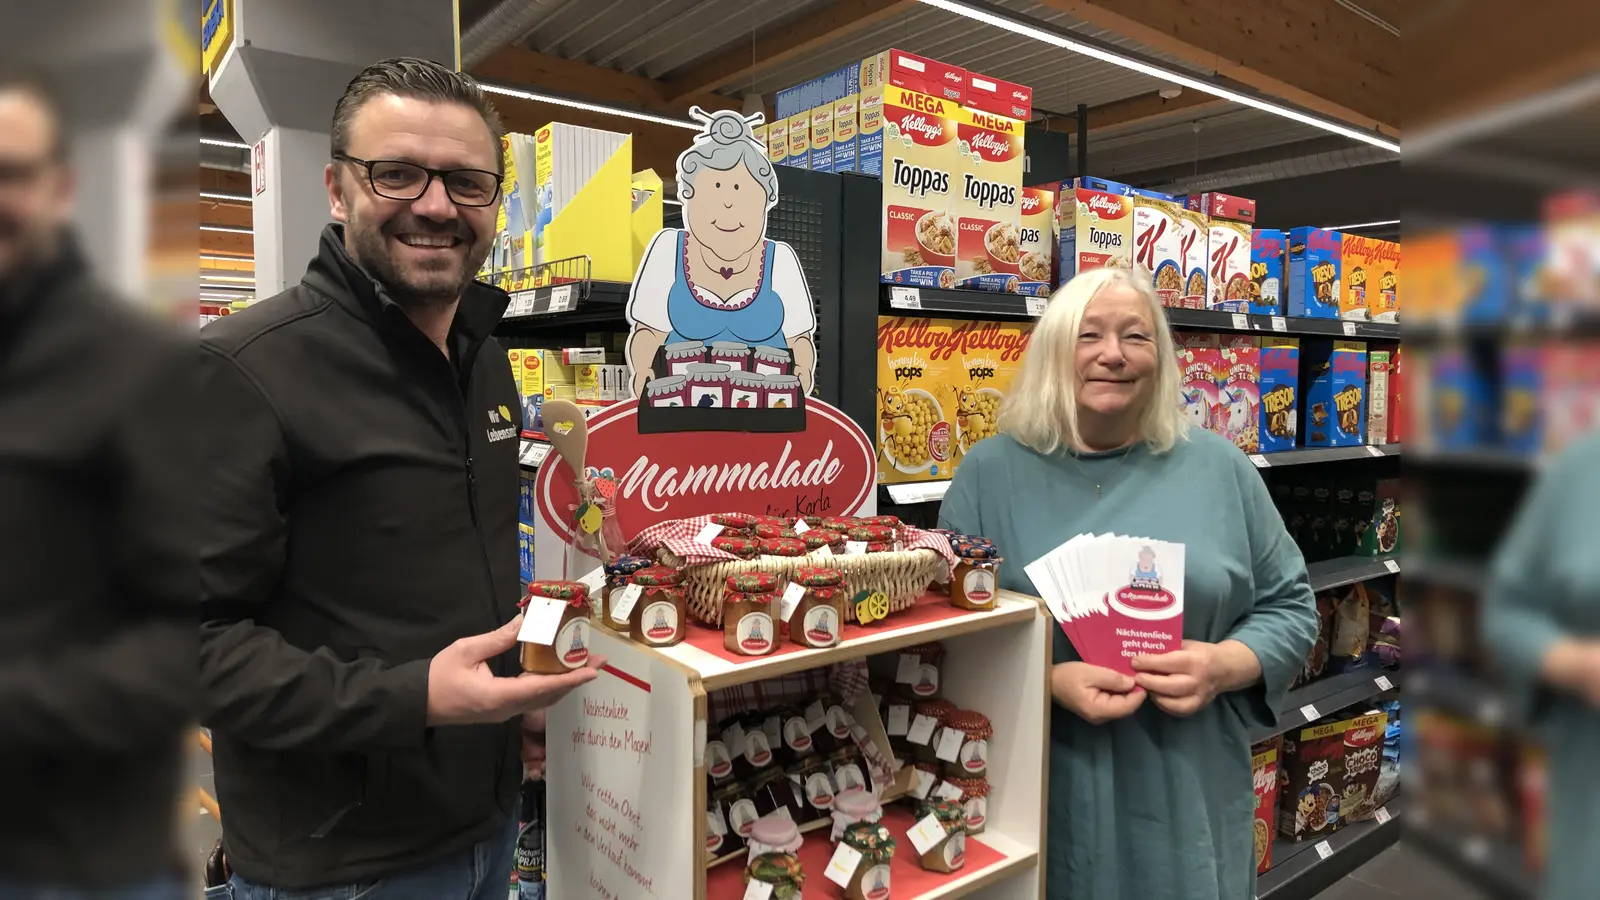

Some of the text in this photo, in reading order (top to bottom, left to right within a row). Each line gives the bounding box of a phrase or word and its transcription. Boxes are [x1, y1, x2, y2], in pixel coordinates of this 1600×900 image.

[900, 91, 945, 115] MEGA
[901, 113, 943, 139] Kellogg's
[972, 114, 1014, 132] MEGA
[869, 143, 882, 151] WIN
[971, 132, 1009, 155] Kellogg's
[843, 150, 855, 158] WIN
[893, 159, 948, 195] Toppas
[965, 175, 1014, 208] Toppas
[1020, 191, 1040, 210] ogg's
[1090, 194, 1121, 214] Kellogg's
[889, 210, 915, 221] CLASSIC
[959, 222, 984, 231] CLASSIC
[1020, 228, 1040, 245] pas
[1090, 227, 1122, 248] Toppas
[1136, 218, 1167, 271] K
[1082, 256, 1100, 264] CLASSIC
[1211, 236, 1238, 283] K
[920, 278, 933, 286] WIN
[1311, 264, 1336, 283] TRESOR
[1348, 270, 1367, 286] TRESOR
[895, 366, 923, 381] pops
[969, 366, 994, 380] pops
[1185, 362, 1212, 375] UNICORN
[1229, 363, 1254, 375] UNICORN
[1263, 387, 1295, 413] TRESOR
[1333, 387, 1362, 412] TRESOR
[487, 410, 500, 424] Wir
[622, 440, 844, 512] Mammalade
[796, 488, 831, 518] Karla
[1116, 628, 1173, 641] Nächstenliebe
[1120, 649, 1136, 658] den
[1122, 640, 1165, 650] geht durch
[583, 696, 630, 721] Nächstenliebe
[1352, 717, 1379, 727] MEGA
[588, 729, 607, 747] durch
[610, 731, 622, 749] den
[1313, 726, 1335, 737] MEGA
[1254, 755, 1267, 765] EGA
[1346, 752, 1377, 768] CHOCO
[581, 771, 595, 792] Wir
[596, 788, 619, 811] retten
[583, 827, 595, 844] den
[618, 830, 639, 852] mehr
